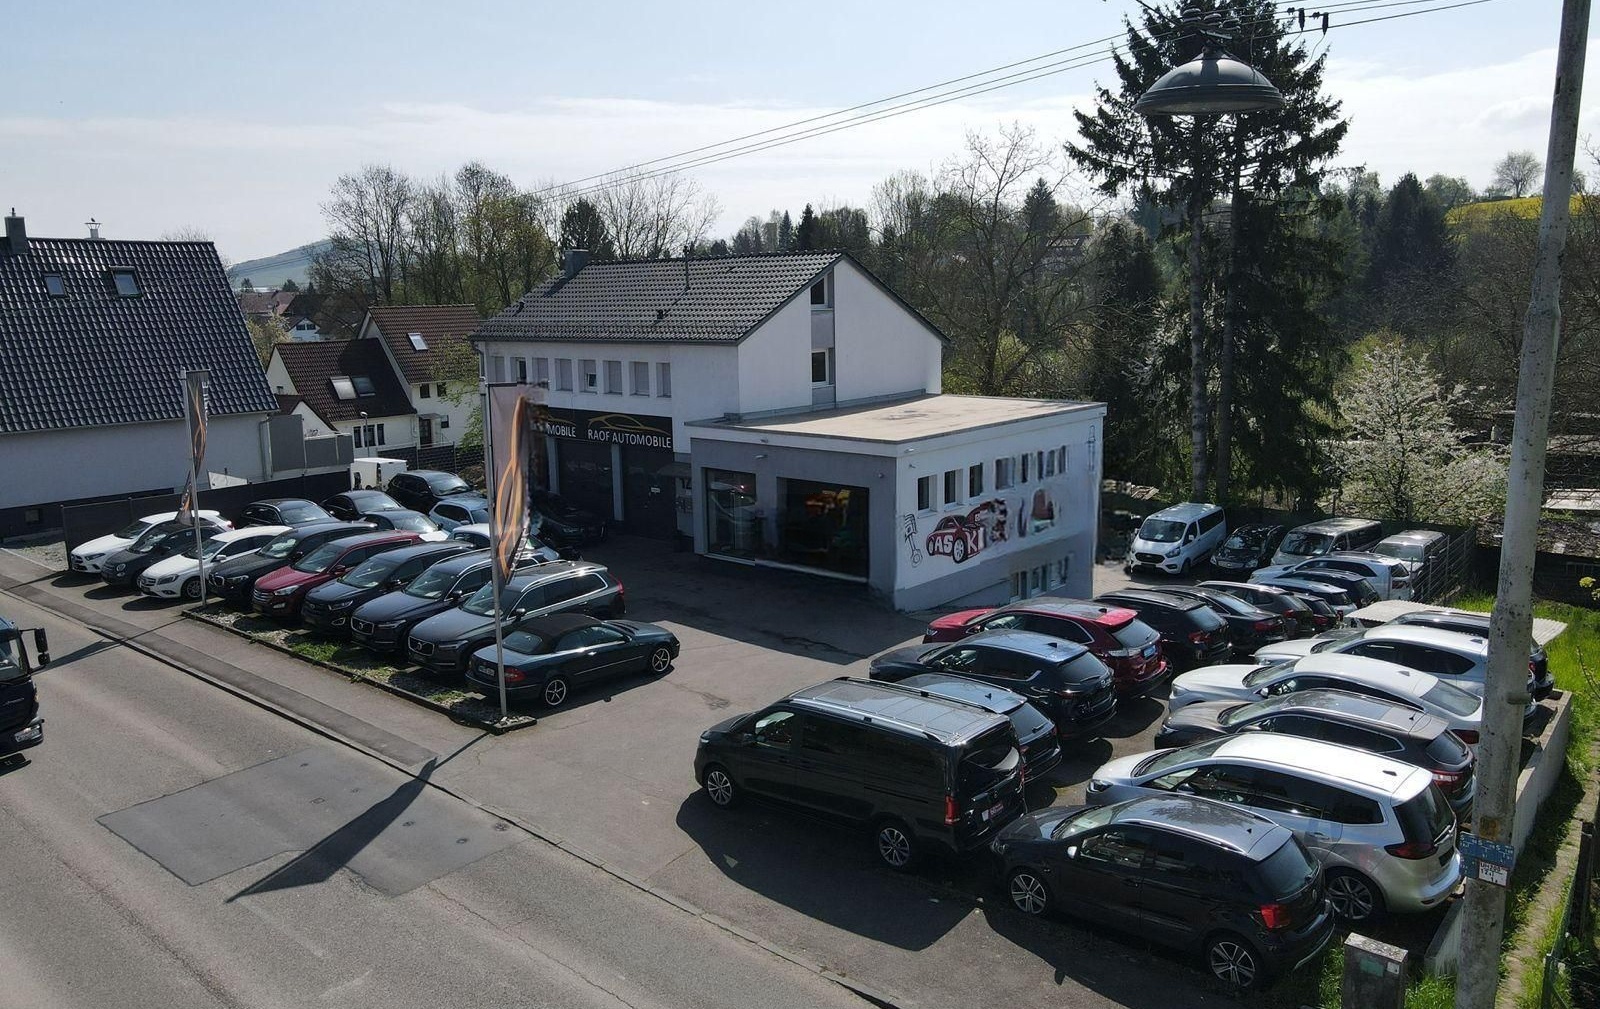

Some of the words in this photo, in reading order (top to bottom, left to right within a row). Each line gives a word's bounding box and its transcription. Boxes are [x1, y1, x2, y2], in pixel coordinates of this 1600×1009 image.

[546, 422, 577, 438] MOBILE
[587, 429, 610, 442] RAOF
[612, 432, 672, 449] AUTOMOBILE
